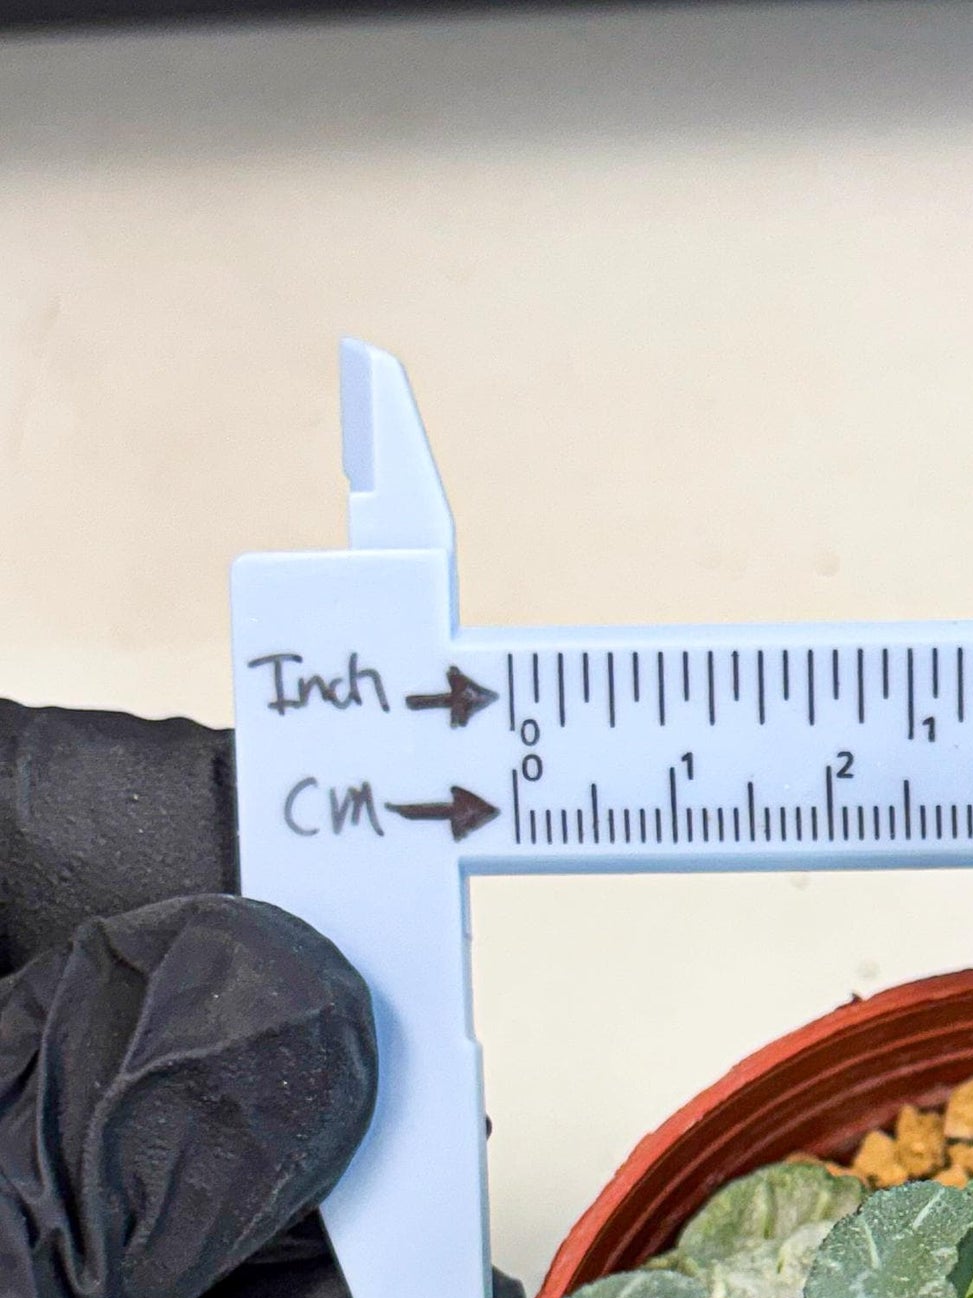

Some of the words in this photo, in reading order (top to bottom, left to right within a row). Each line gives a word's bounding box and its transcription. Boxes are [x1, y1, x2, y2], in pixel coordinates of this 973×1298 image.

[248, 653, 390, 716] Inch
[520, 719, 540, 746] 0
[922, 716, 936, 742] 1
[521, 754, 543, 782] 0
[681, 752, 694, 780] 1
[838, 751, 854, 779] 2
